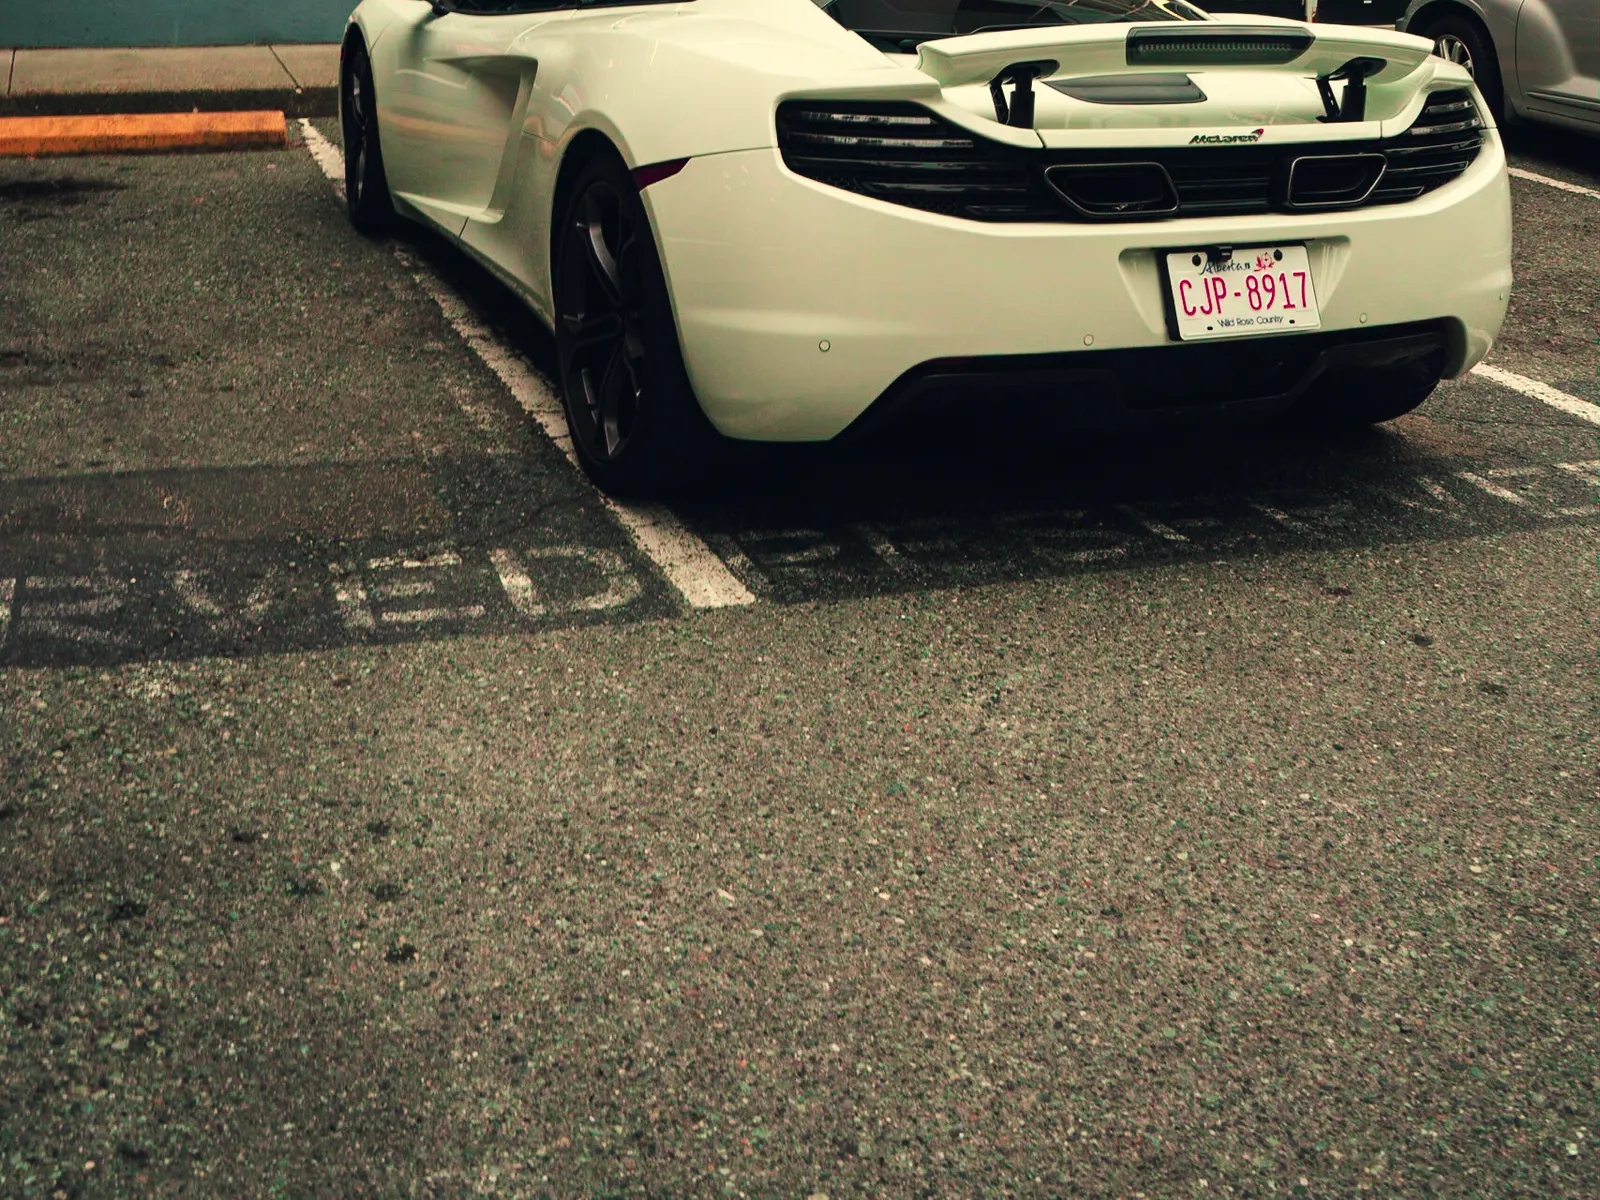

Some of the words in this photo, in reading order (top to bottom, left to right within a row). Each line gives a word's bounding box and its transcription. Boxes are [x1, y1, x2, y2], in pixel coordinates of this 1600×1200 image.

[1188, 135, 1259, 145] McLaren
[1179, 271, 1307, 317] CJP-8917
[1217, 319, 1235, 328] Wild
[1236, 317, 1254, 326] Rose
